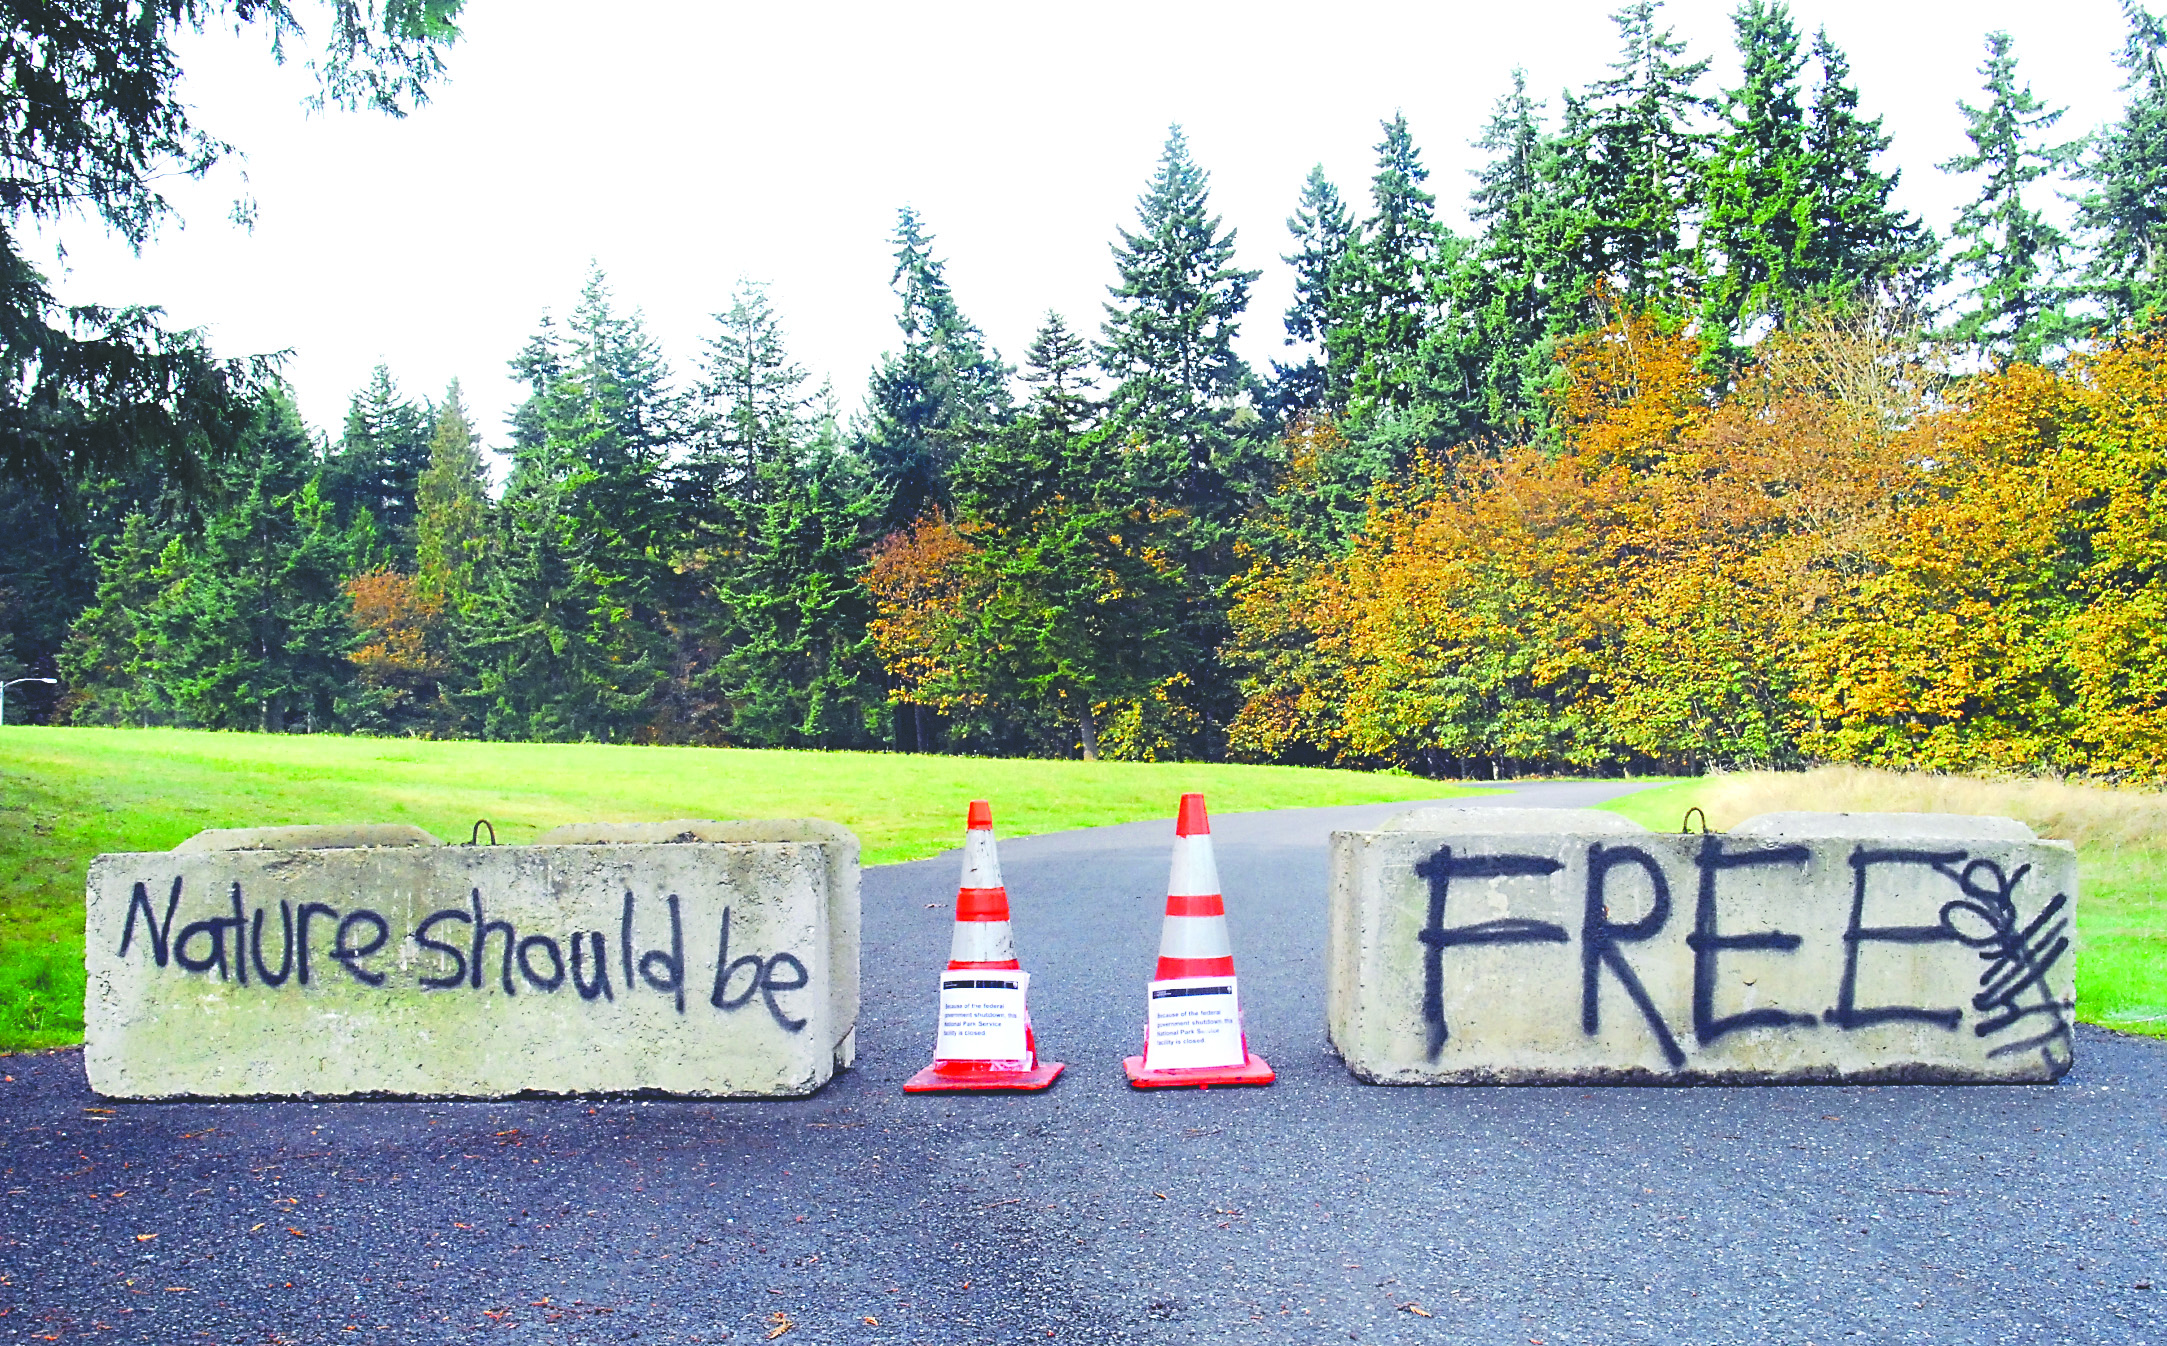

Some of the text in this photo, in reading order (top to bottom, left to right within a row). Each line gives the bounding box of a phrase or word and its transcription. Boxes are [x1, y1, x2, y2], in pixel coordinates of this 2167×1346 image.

[118, 876, 808, 1033] Nature should be
[1414, 835, 1968, 1068] FREE
